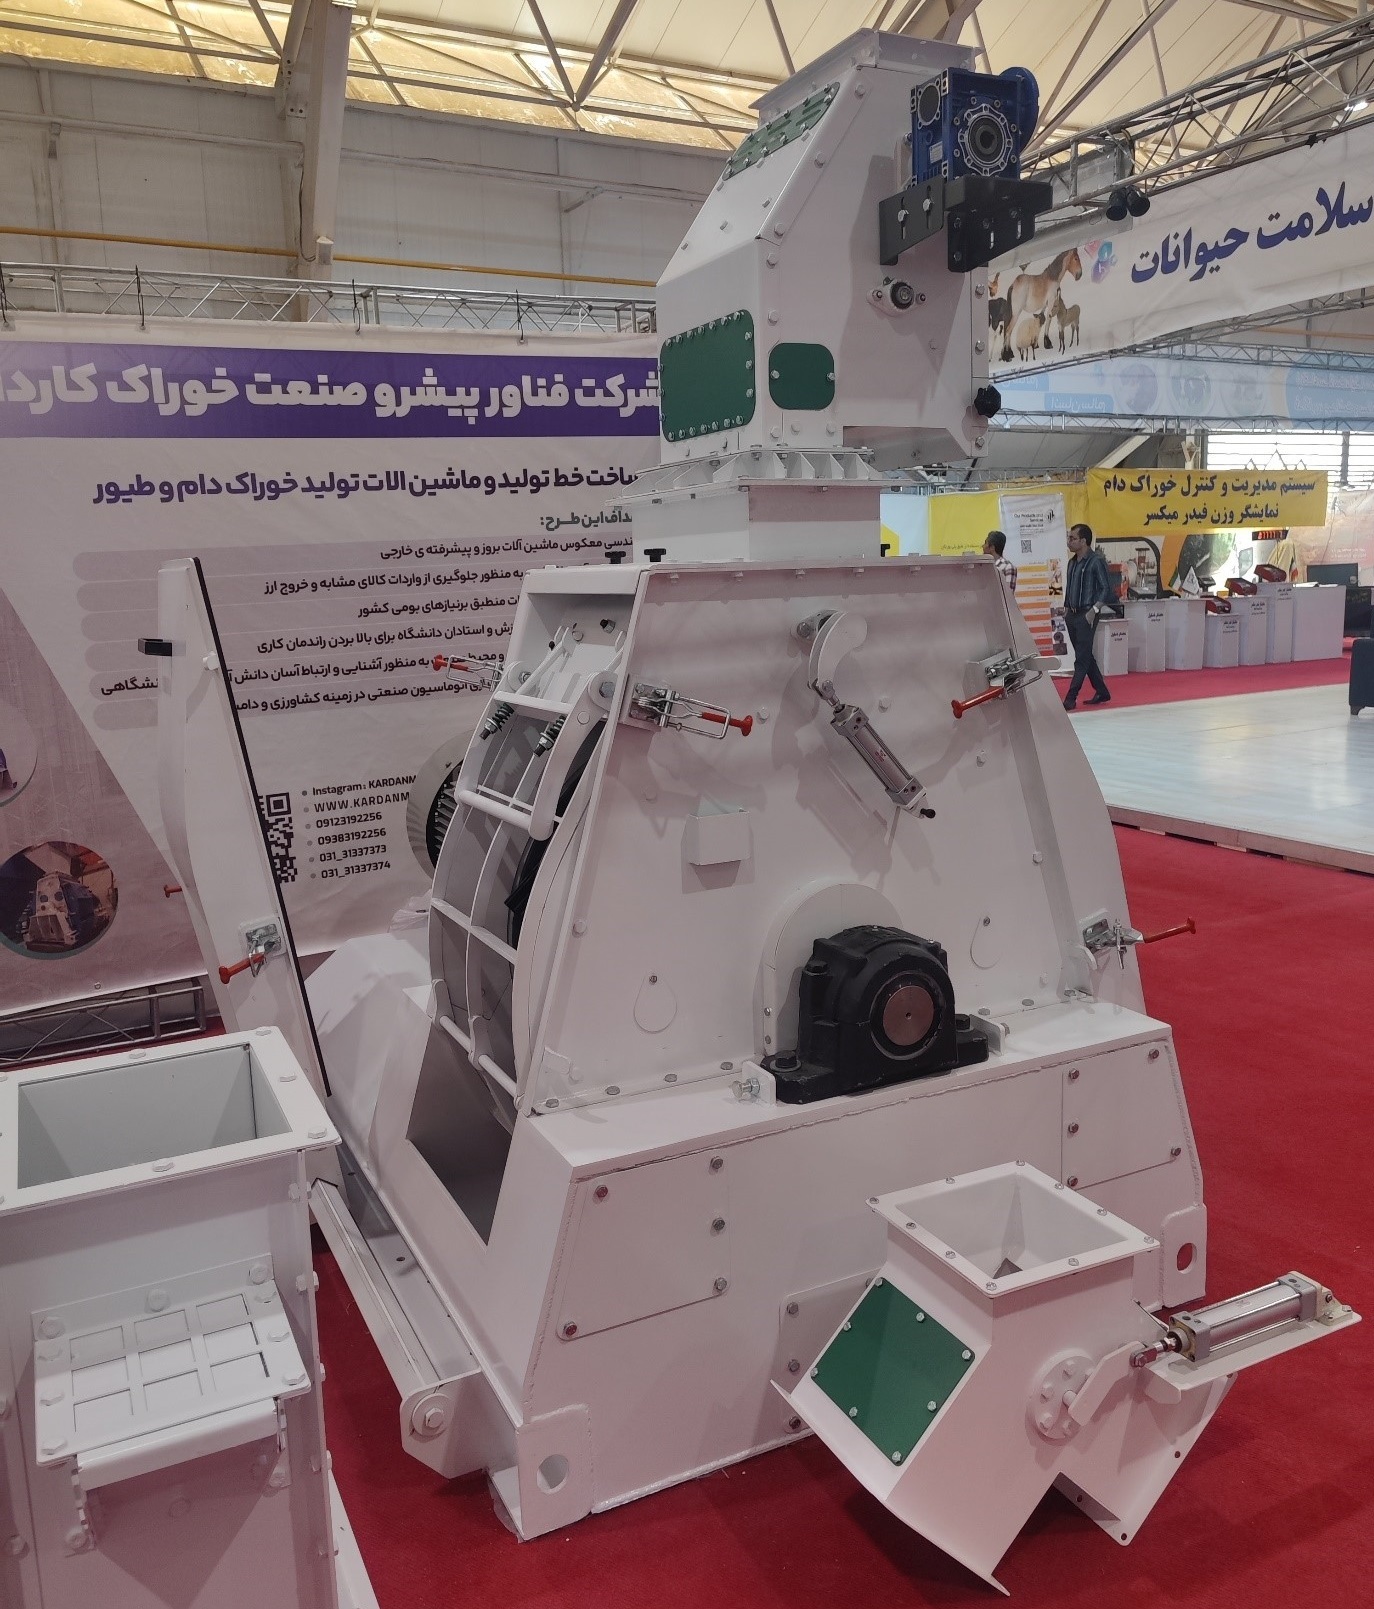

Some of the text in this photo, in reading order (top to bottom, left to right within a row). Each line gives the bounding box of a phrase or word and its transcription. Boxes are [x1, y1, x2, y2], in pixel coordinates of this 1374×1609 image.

[1130, 180, 1374, 284] سلامت حیوانات
[105, 363, 240, 417] خوراک
[245, 373, 368, 406] صنعت
[373, 367, 481, 425] پیشرو
[484, 373, 570, 418] فناور
[574, 371, 660, 418] شرکت
[301, 472, 360, 498] تولید
[362, 470, 405, 492] الات
[408, 467, 481, 497] ماشین
[484, 475, 496, 495] و
[498, 469, 550, 495] تولید
[553, 467, 585, 488] خط
[92, 474, 155, 504] طیور
[159, 481, 175, 502] و
[177, 473, 222, 502] دام
[226, 472, 299, 501] خوراک
[1103, 474, 1316, 498] سیستم مدیریت و کنترل خوراک دام
[581, 511, 604, 528] این
[1143, 502, 1279, 526] نمایشگر وزن فیدر میکسر
[380, 544, 412, 560] خارجی
[426, 541, 472, 558] پیشرفته
[474, 544, 480, 555] و
[481, 542, 500, 555] بروز
[502, 538, 522, 551] آلات
[523, 539, 558, 554] ماشین
[560, 538, 602, 551] معکوس
[415, 548, 424, 558] ی
[264, 568, 523, 595] به منظور جلوگیری از واردات کالای مشابه و خروج ارز
[358, 602, 389, 618] کشور
[391, 603, 419, 617] بومی
[470, 596, 505, 610] منطبق
[356, 632, 372, 646] بالا
[374, 630, 395, 645] برای
[397, 627, 443, 642] دانشگاه
[444, 624, 485, 640] استادان
[486, 627, 493, 637] و
[257, 638, 284, 653] کاری
[286, 635, 326, 651] راندمان
[328, 636, 354, 648] بردن
[341, 657, 383, 675] آشنایی
[383, 656, 417, 672] منظور
[418, 657, 430, 666] به
[234, 668, 269, 684] دانش
[271, 663, 301, 682] آسان
[301, 663, 331, 678] ارتباط
[333, 665, 340, 676] و
[270, 692, 321, 711] کشاورزی
[322, 691, 352, 704] زمینه
[354, 690, 366, 703] در
[367, 687, 408, 701] صنعتی
[261, 700, 268, 711] و
[314, 792, 409, 812] WWW.KARDANM
[316, 812, 382, 828] 09123192256
[318, 828, 386, 845] 09383192256
[320, 845, 386, 861] 031_31337373
[321, 861, 390, 878] 031_31337374
